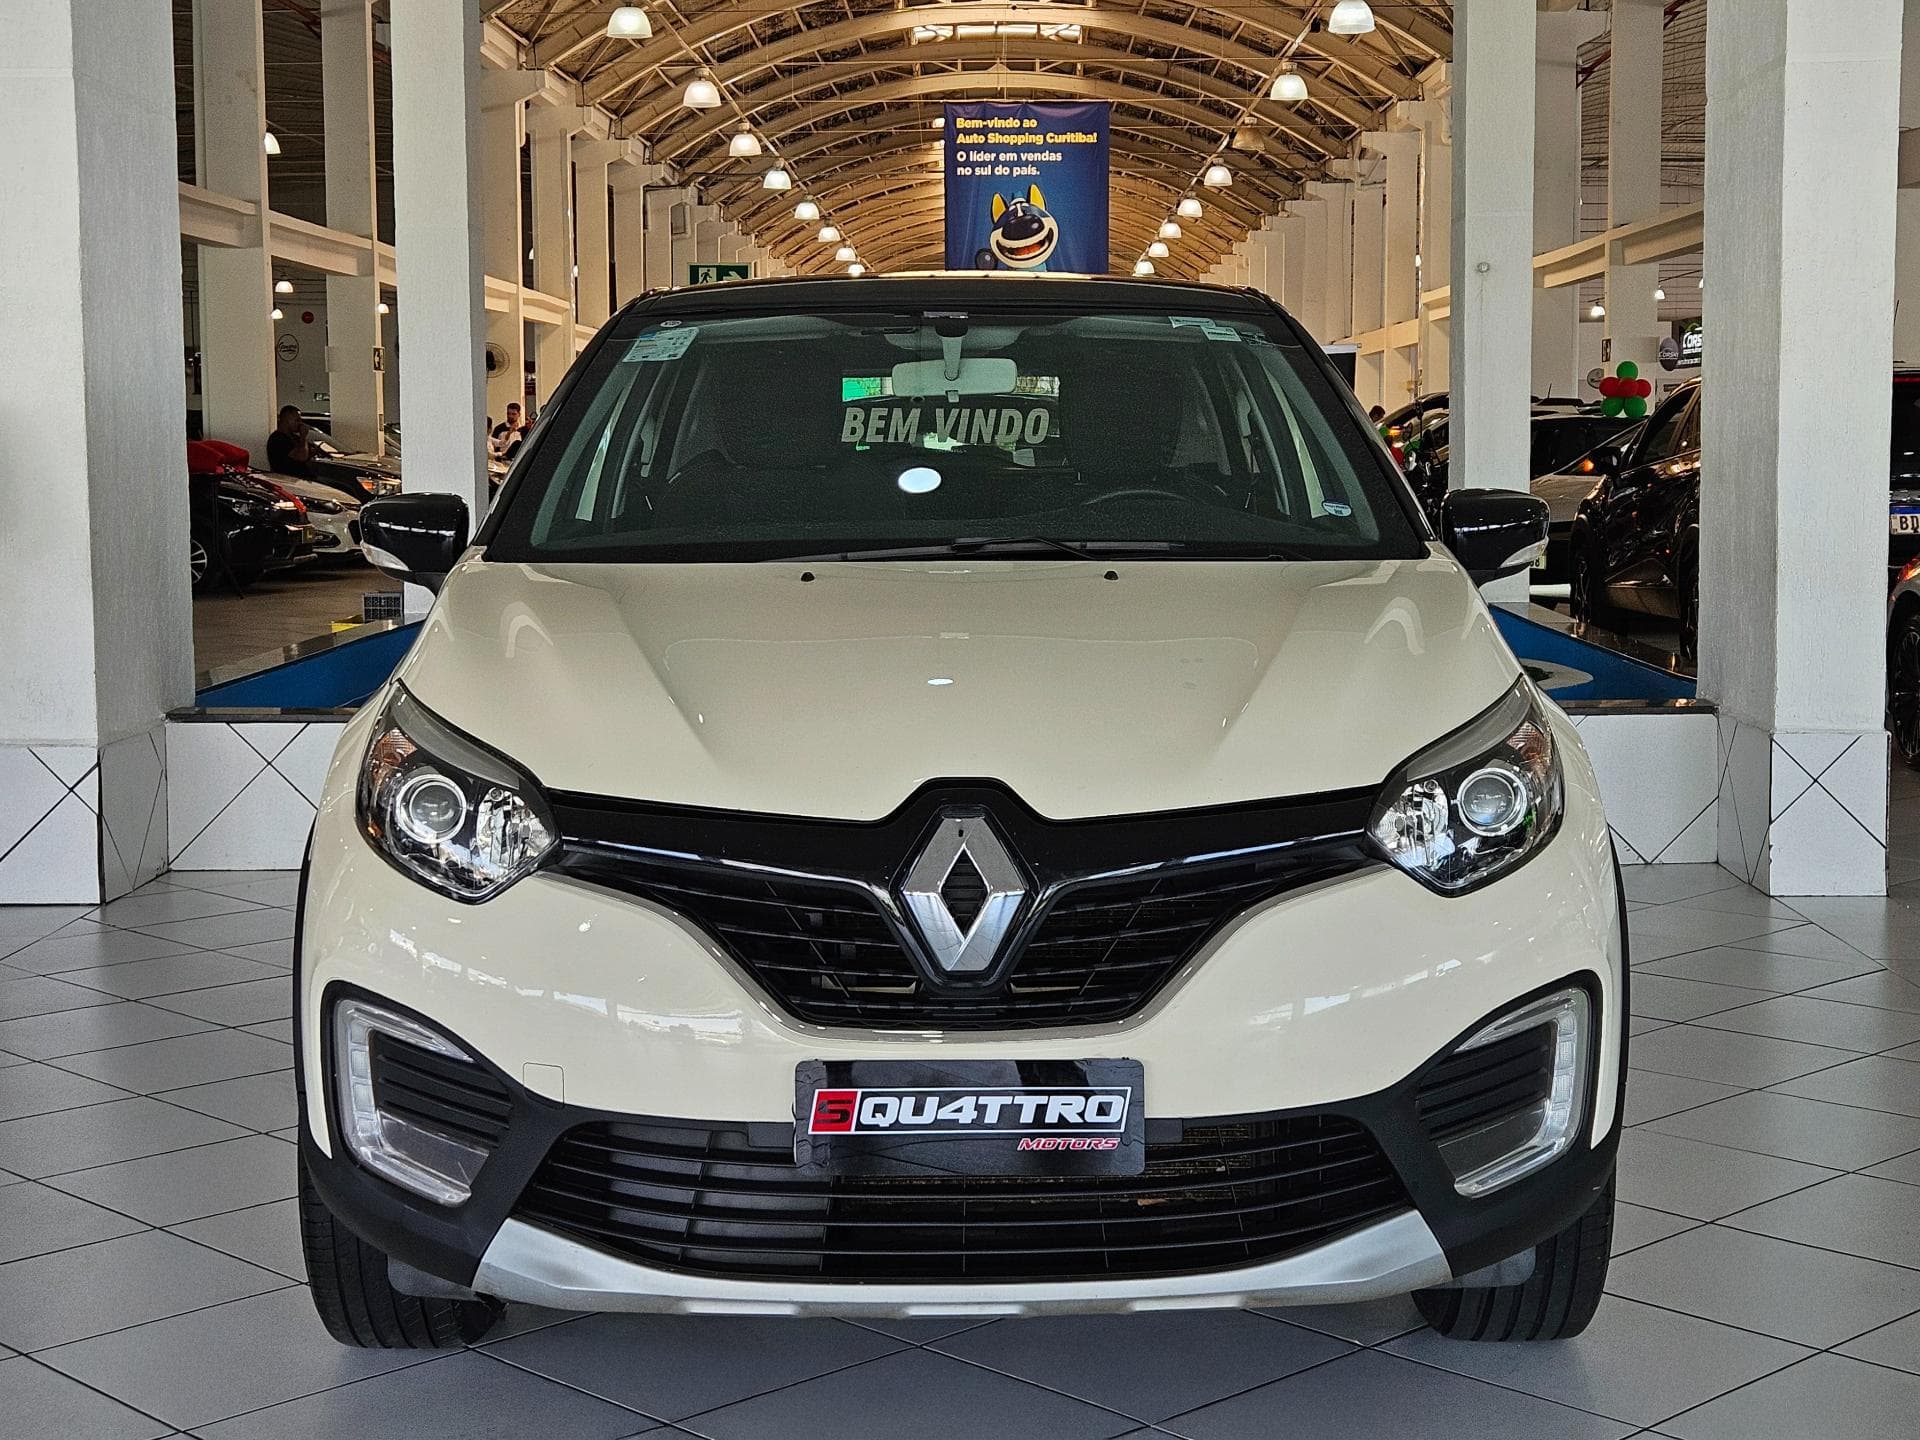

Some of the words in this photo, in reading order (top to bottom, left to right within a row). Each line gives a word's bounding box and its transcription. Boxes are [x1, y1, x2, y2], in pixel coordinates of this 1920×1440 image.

[956, 117, 1021, 128] Bem-vindo
[1022, 119, 1038, 128] ao
[956, 133, 986, 144] Auto
[987, 132, 1044, 145] Shopping
[1045, 132, 1098, 143] Curitiba!
[956, 151, 967, 162] O
[969, 150, 997, 162] líder
[998, 152, 1018, 161] em
[1020, 150, 1062, 161] vendas
[956, 166, 972, 175] no
[974, 164, 992, 175] sul
[994, 164, 1010, 175] do
[1012, 164, 1041, 177] país.
[841, 407, 922, 443] BEM
[935, 407, 1051, 445] VINDO
[1017, 1137, 1121, 1151] MOTORS
